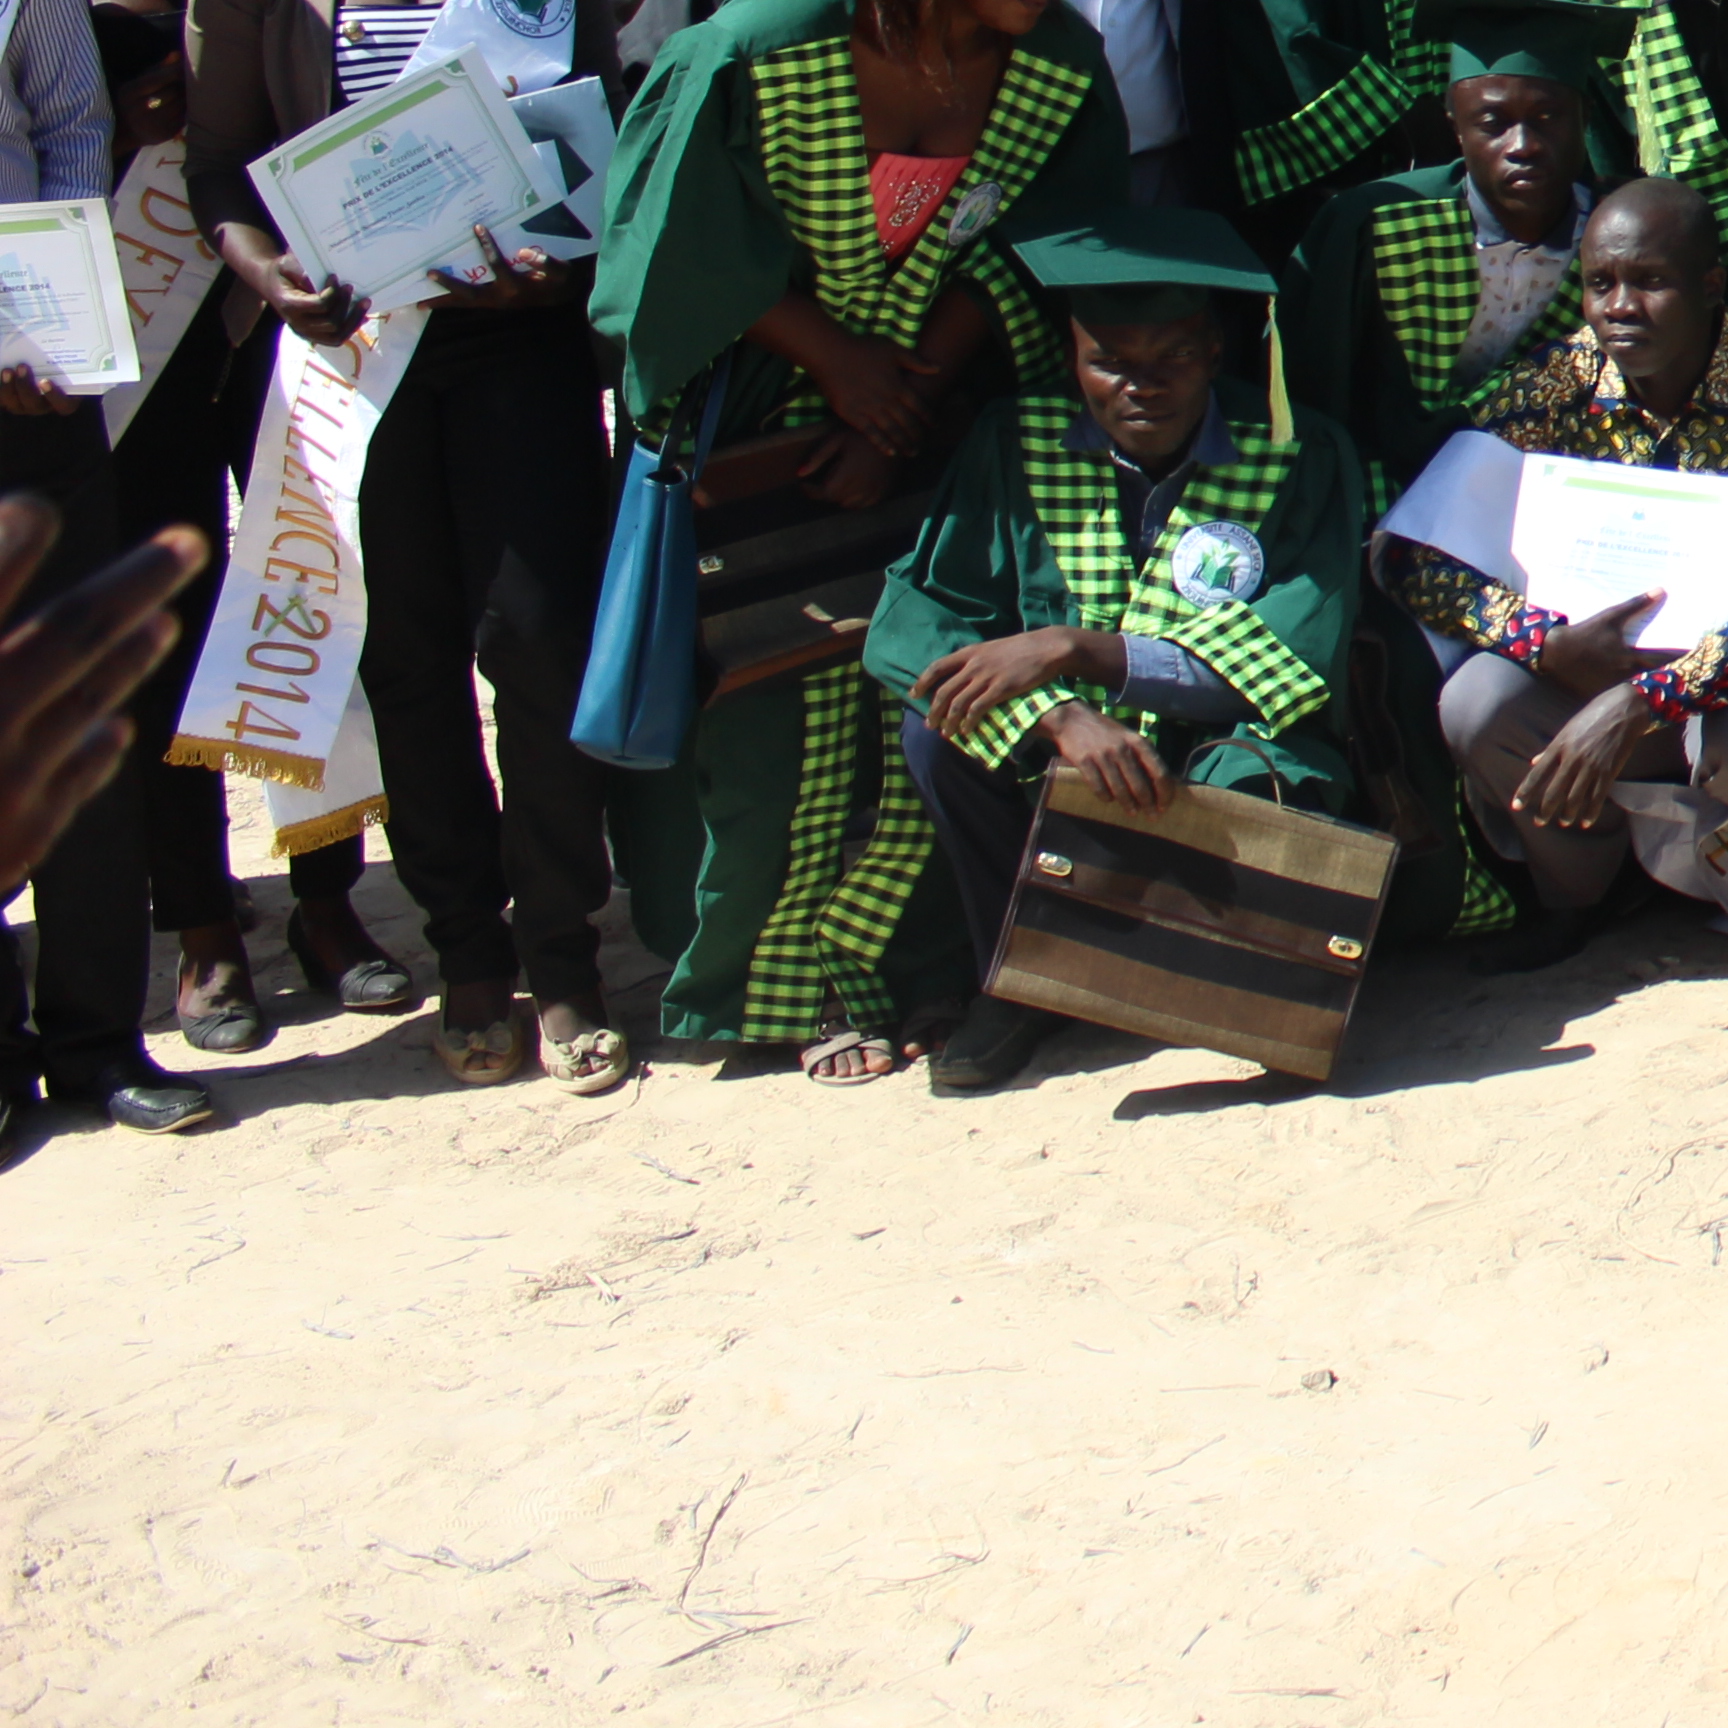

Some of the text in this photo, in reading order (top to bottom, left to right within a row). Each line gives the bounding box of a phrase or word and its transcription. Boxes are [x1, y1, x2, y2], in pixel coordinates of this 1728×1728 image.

[342, 145, 453, 210] PRIX DE L'EXCELLENCE 2014
[29, 283, 51, 292] 2014
[1228, 525, 1259, 551] ASSANE
[225, 593, 332, 742] 2014
